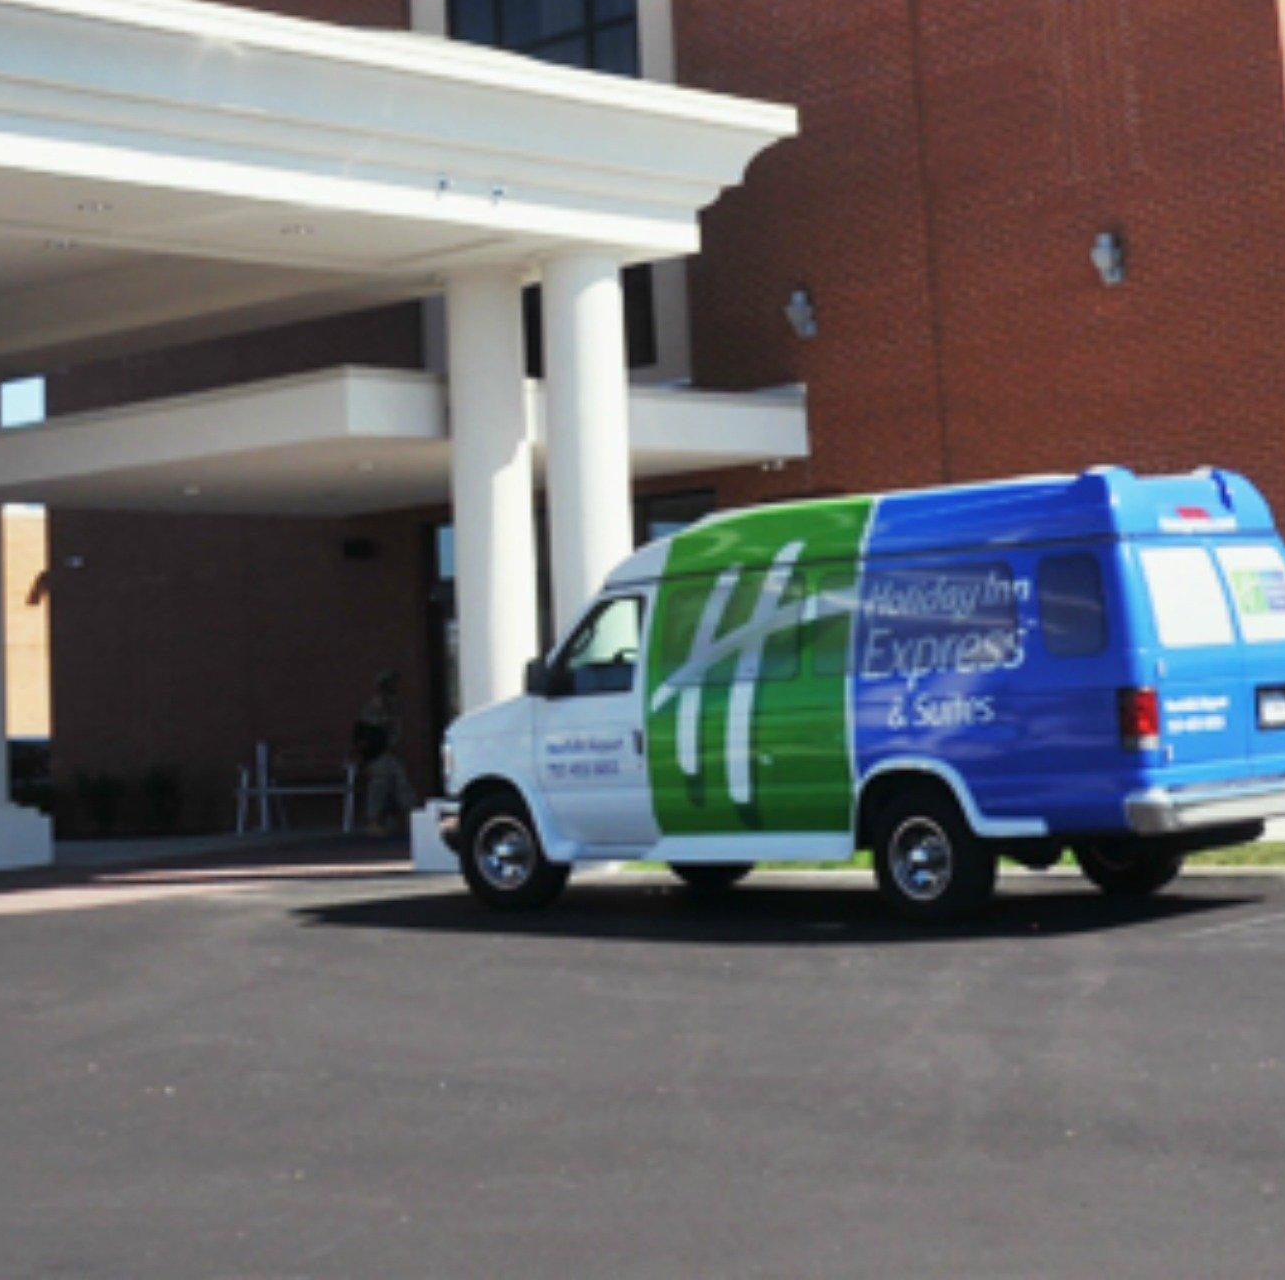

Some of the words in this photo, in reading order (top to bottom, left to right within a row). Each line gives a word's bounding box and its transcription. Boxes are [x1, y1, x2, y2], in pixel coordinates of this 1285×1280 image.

[866, 575, 982, 621] Holiday
[983, 571, 1031, 604] Inn
[859, 627, 1028, 691] Express
[886, 694, 908, 731] &
[913, 691, 996, 727] Suites
